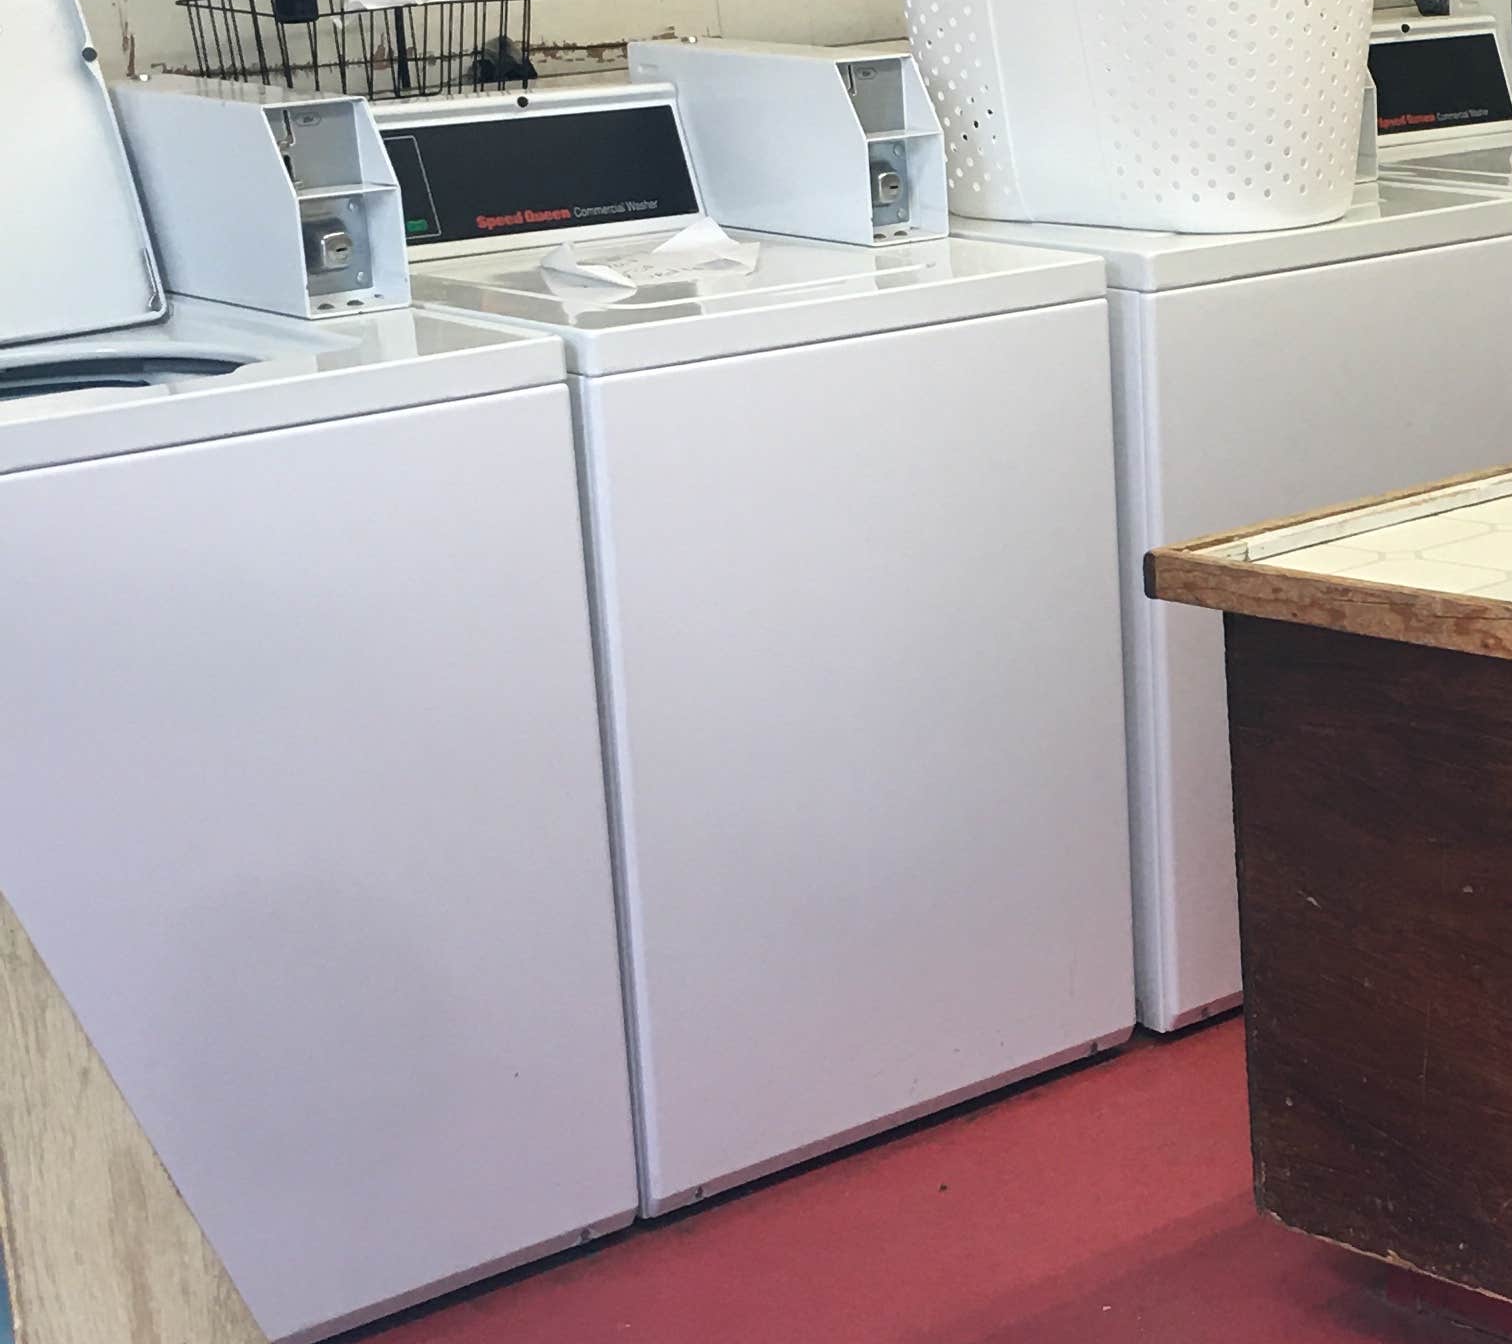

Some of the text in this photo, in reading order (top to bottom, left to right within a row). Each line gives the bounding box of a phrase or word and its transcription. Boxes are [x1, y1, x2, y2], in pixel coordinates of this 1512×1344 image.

[476, 199, 658, 230] Speed Queen Commercial Washer
